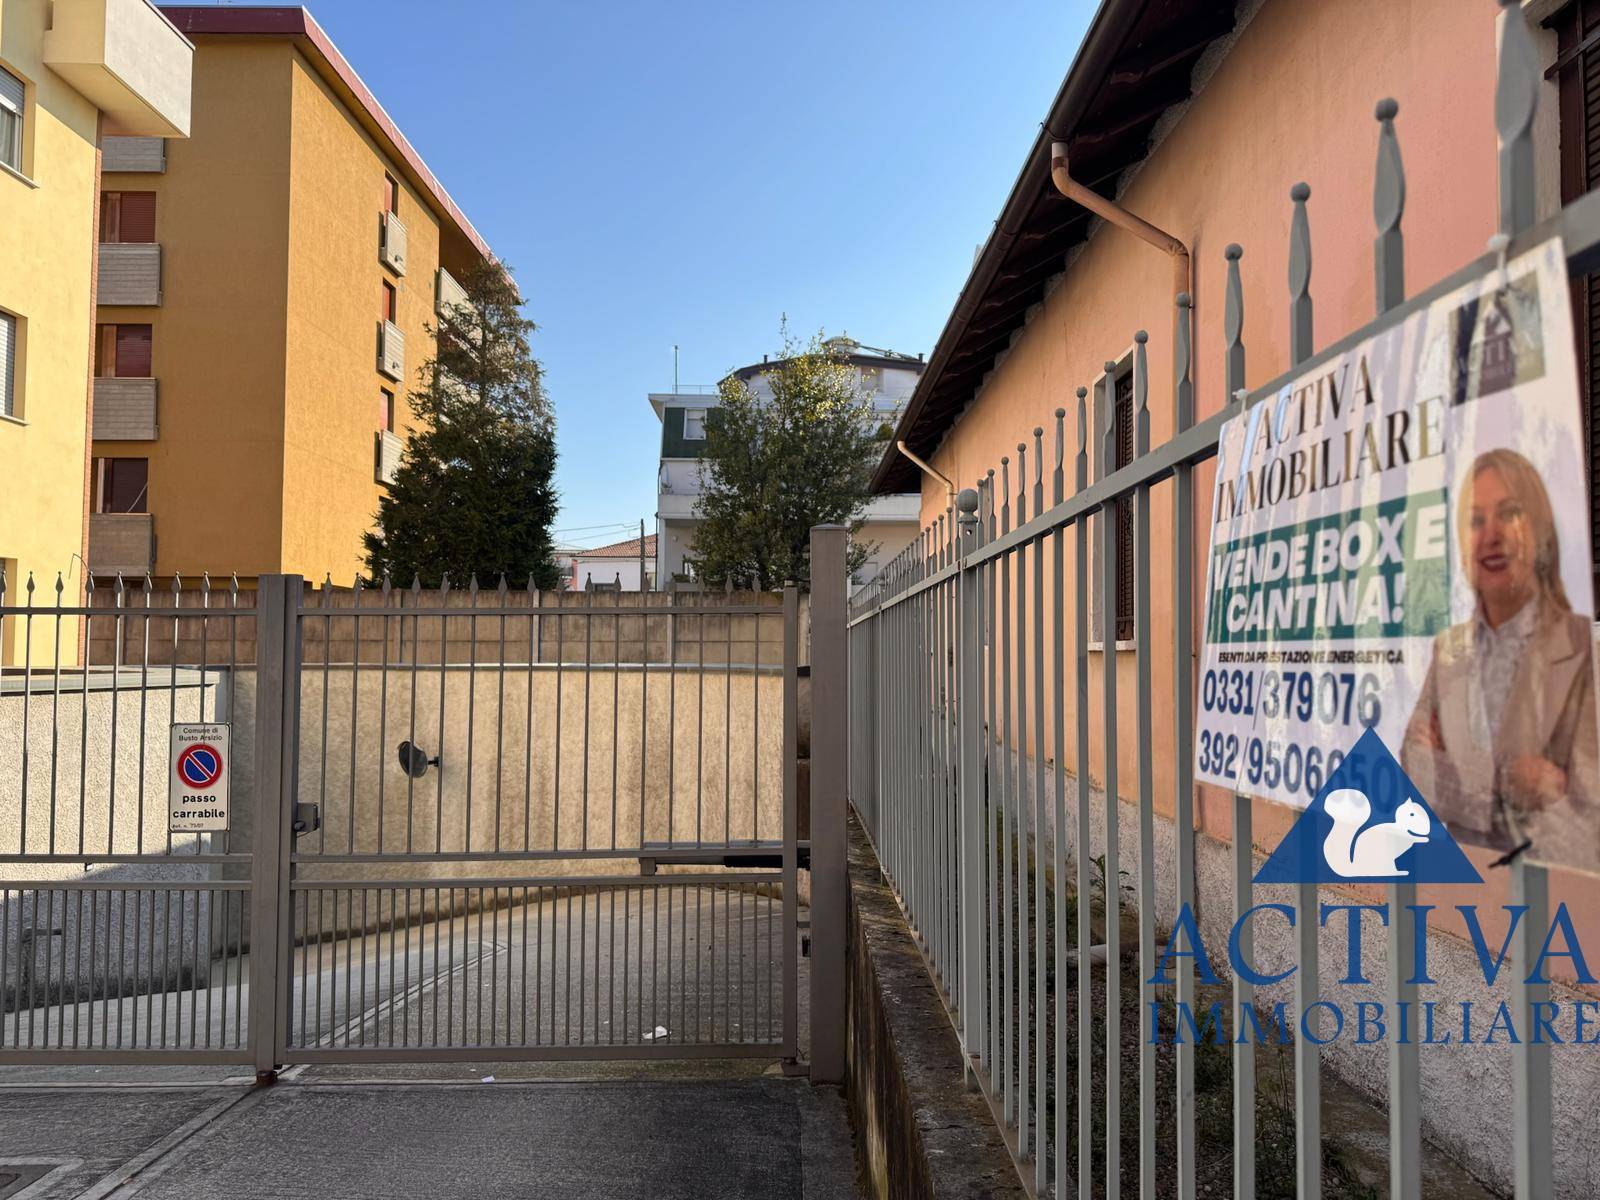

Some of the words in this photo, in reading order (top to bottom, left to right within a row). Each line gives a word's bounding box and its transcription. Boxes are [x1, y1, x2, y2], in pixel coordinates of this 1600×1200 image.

[1255, 355, 1375, 456] ACTIVA
[1216, 395, 1446, 524] IMMOBILIARE
[1213, 534, 1309, 592] VENDE
[1311, 511, 1407, 576] BOX
[1413, 503, 1447, 561] E
[1225, 573, 1407, 633] CANTINA!
[1218, 651, 1243, 663] ESENTI
[1244, 651, 1257, 663] DA
[1257, 650, 1326, 664] PRESTAZIONE
[1327, 649, 1404, 664] ENERGETICA
[1203, 668, 1381, 730] 0331/379076
[211, 726, 219, 734] di
[172, 808, 225, 818] carrabile
[182, 795, 216, 804] passo
